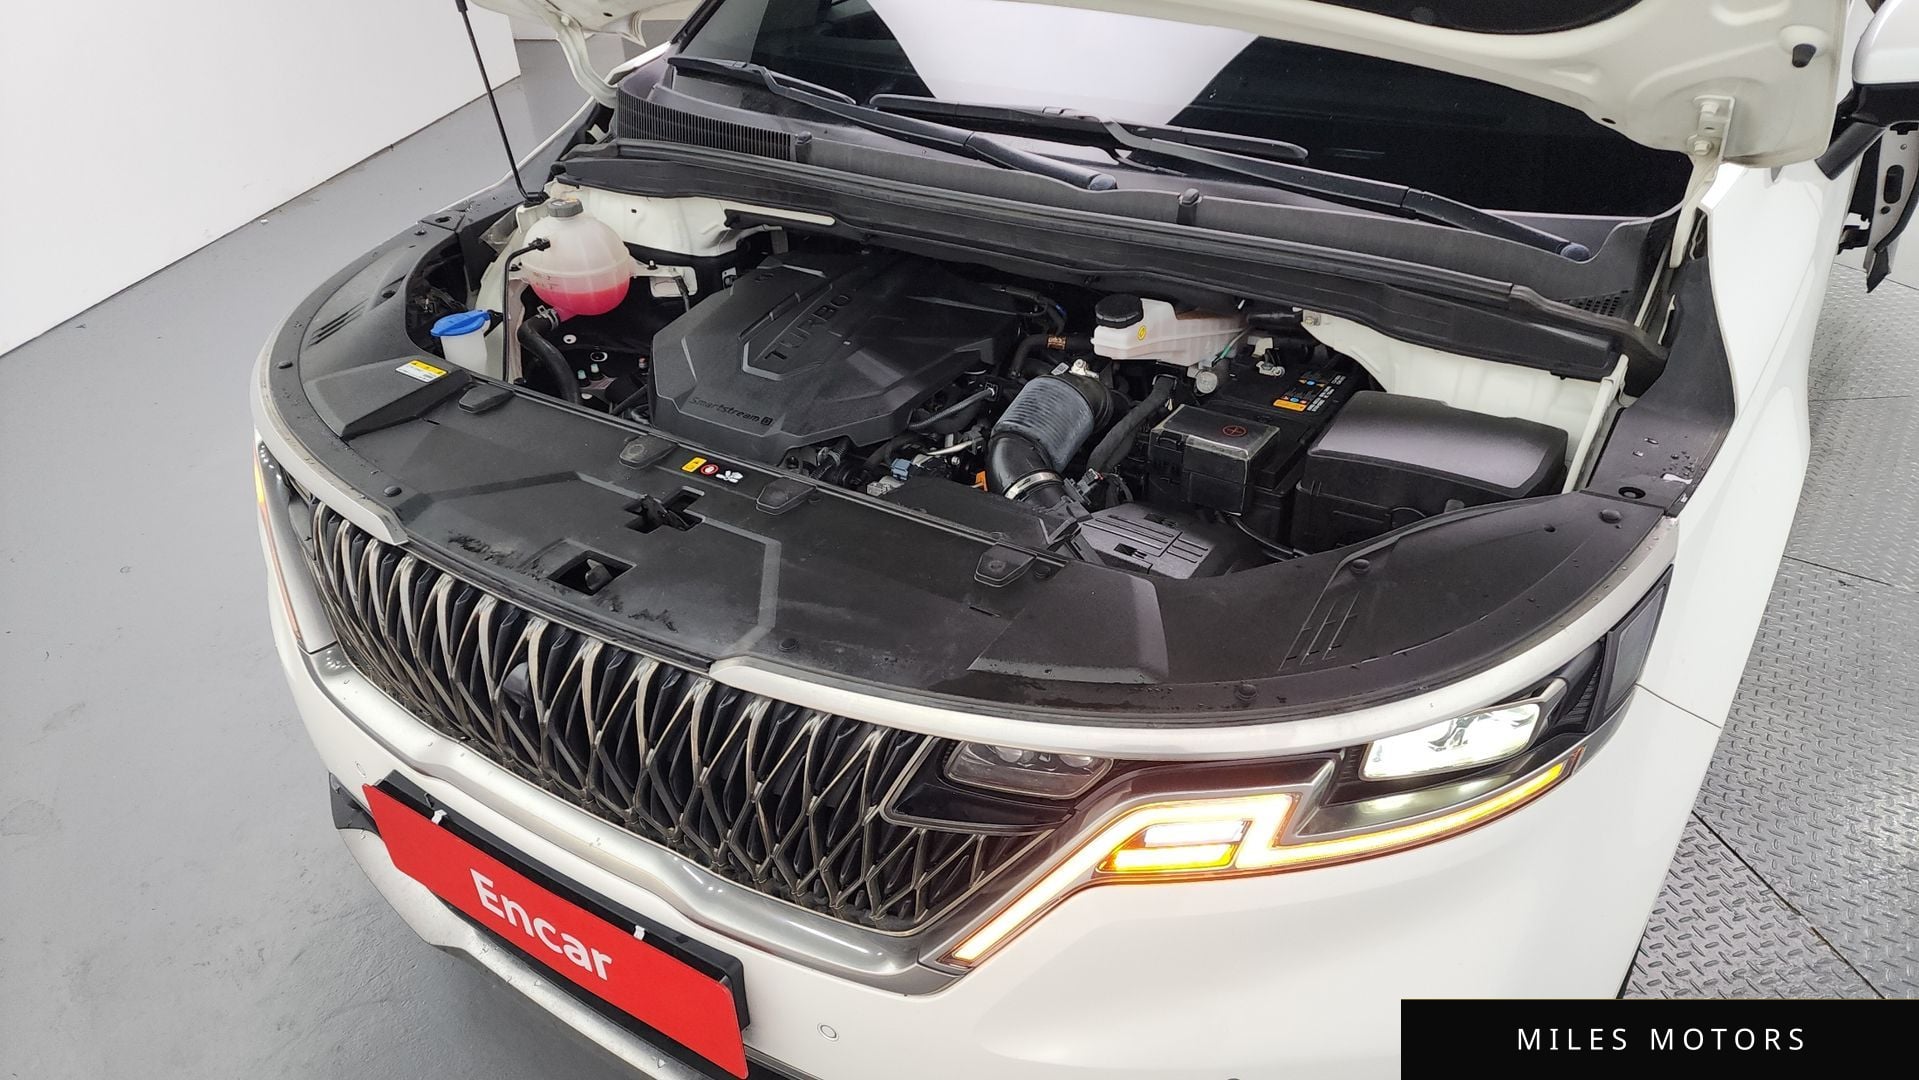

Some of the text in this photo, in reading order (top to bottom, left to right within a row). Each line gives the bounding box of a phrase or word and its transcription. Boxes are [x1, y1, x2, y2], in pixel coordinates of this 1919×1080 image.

[764, 294, 851, 360] TURBO
[689, 397, 761, 422] Smartstream
[470, 868, 613, 981] Encar
